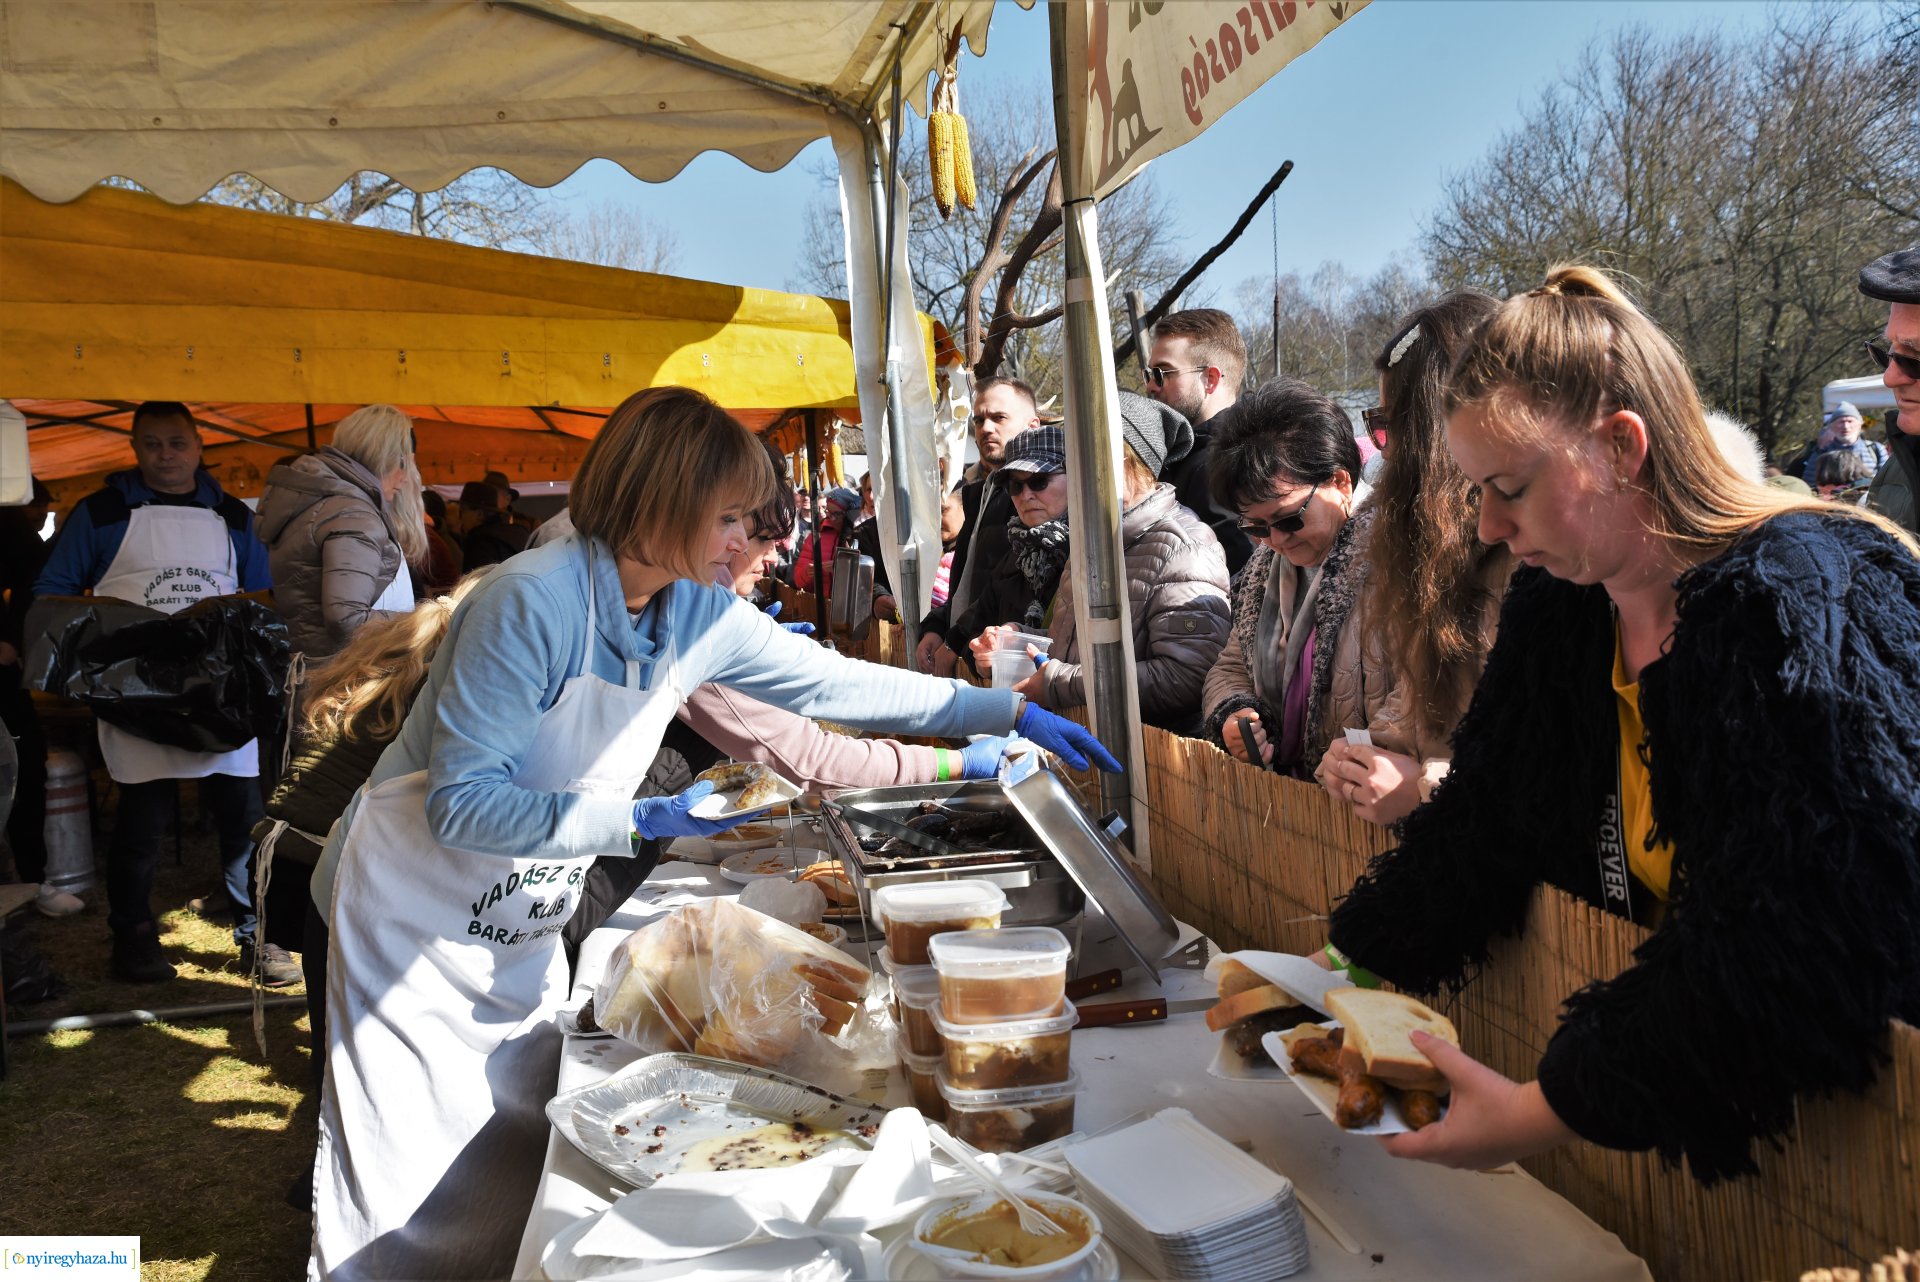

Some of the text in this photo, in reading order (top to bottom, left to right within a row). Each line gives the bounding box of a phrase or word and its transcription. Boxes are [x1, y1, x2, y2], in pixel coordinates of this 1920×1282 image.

[143, 567, 181, 599] VADÁSZ
[171, 584, 202, 592] KLUB
[145, 596, 181, 607] BARÁTI
[471, 863, 565, 917] VADÁSZ
[527, 897, 566, 920] KLUB
[467, 920, 566, 946] BARÁTI TÁRSAS
